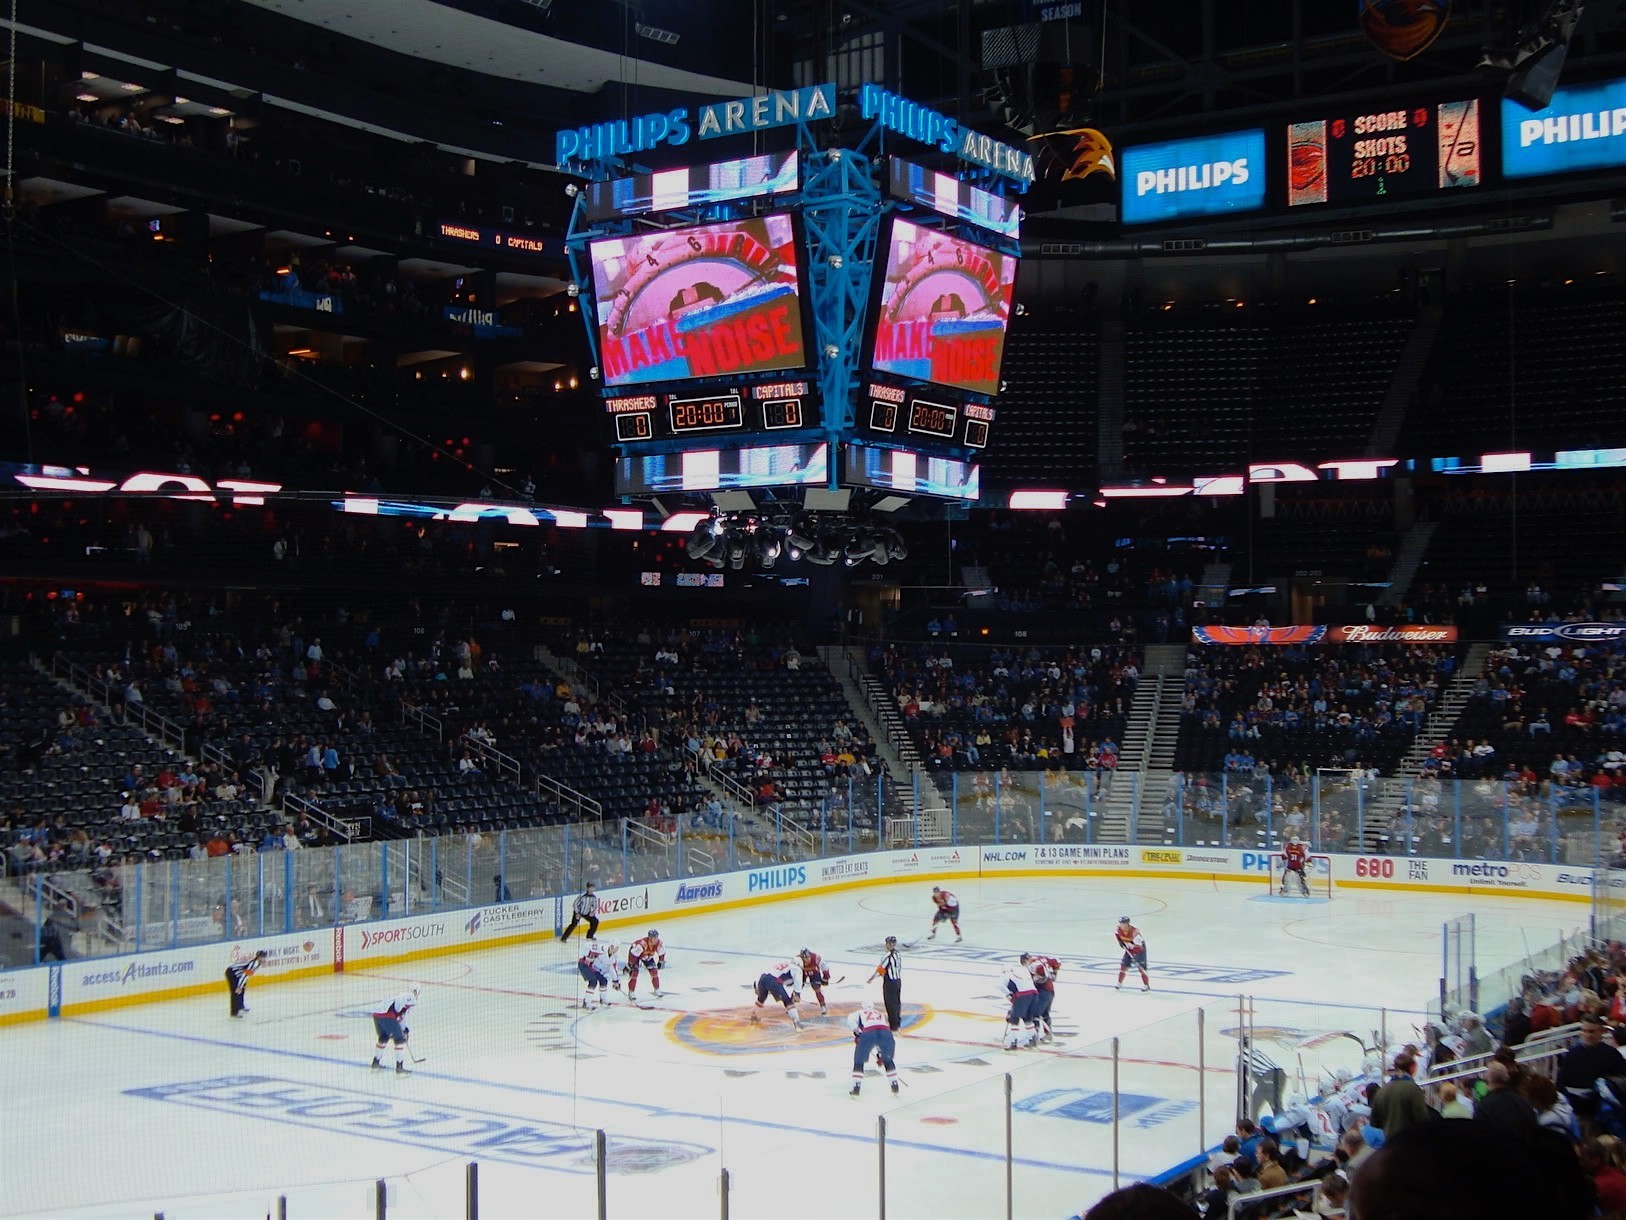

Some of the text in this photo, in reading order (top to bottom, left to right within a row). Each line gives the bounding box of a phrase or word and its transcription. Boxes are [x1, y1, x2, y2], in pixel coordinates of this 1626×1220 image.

[1041, 3, 1081, 22] SEASON
[556, 85, 831, 164] PHILIPS ARENA
[862, 82, 1036, 182] PHILIPS ARENA
[1354, 110, 1407, 134] SCORE
[1354, 135, 1407, 158] SHOTS
[1137, 158, 1250, 197] PHILIPS
[441, 225, 480, 241] THRASHERS
[508, 237, 543, 251] CAPITALS
[601, 305, 800, 378] MAKE NOISE
[932, 337, 998, 383] NOISE
[756, 382, 804, 399] CAPITALS
[870, 384, 905, 402] THRASHERS
[606, 396, 656, 412] THRASHERS
[676, 403, 724, 426] 20:00
[785, 403, 797, 424] 0
[965, 404, 994, 420] CAPITALS
[636, 416, 647, 436] 0
[913, 408, 946, 431] 20:00
[1343, 624, 1448, 642] Budweiser
[1508, 626, 1553, 637] BUD
[984, 851, 1026, 862] NHL.COM
[1059, 848, 1081, 858] GAME
[1083, 848, 1101, 858] MINI
[1103, 848, 1129, 858] PLANS
[822, 864, 844, 877] UNLIMITED
[854, 862, 868, 872] SEATS
[1356, 858, 1394, 879] 680
[1408, 860, 1428, 871] THE
[1409, 870, 1428, 881] FAN
[1453, 862, 1541, 881] metroPCS
[748, 866, 806, 892] PHILIPS
[676, 881, 723, 903] Aaron's
[483, 908, 544, 923] CASTLEBERRY
[484, 905, 519, 916] TUCKER
[371, 923, 445, 945] SPORTSOUTH
[335, 928, 343, 963] Reebok
[82, 961, 194, 986] accessAtlanta.com
